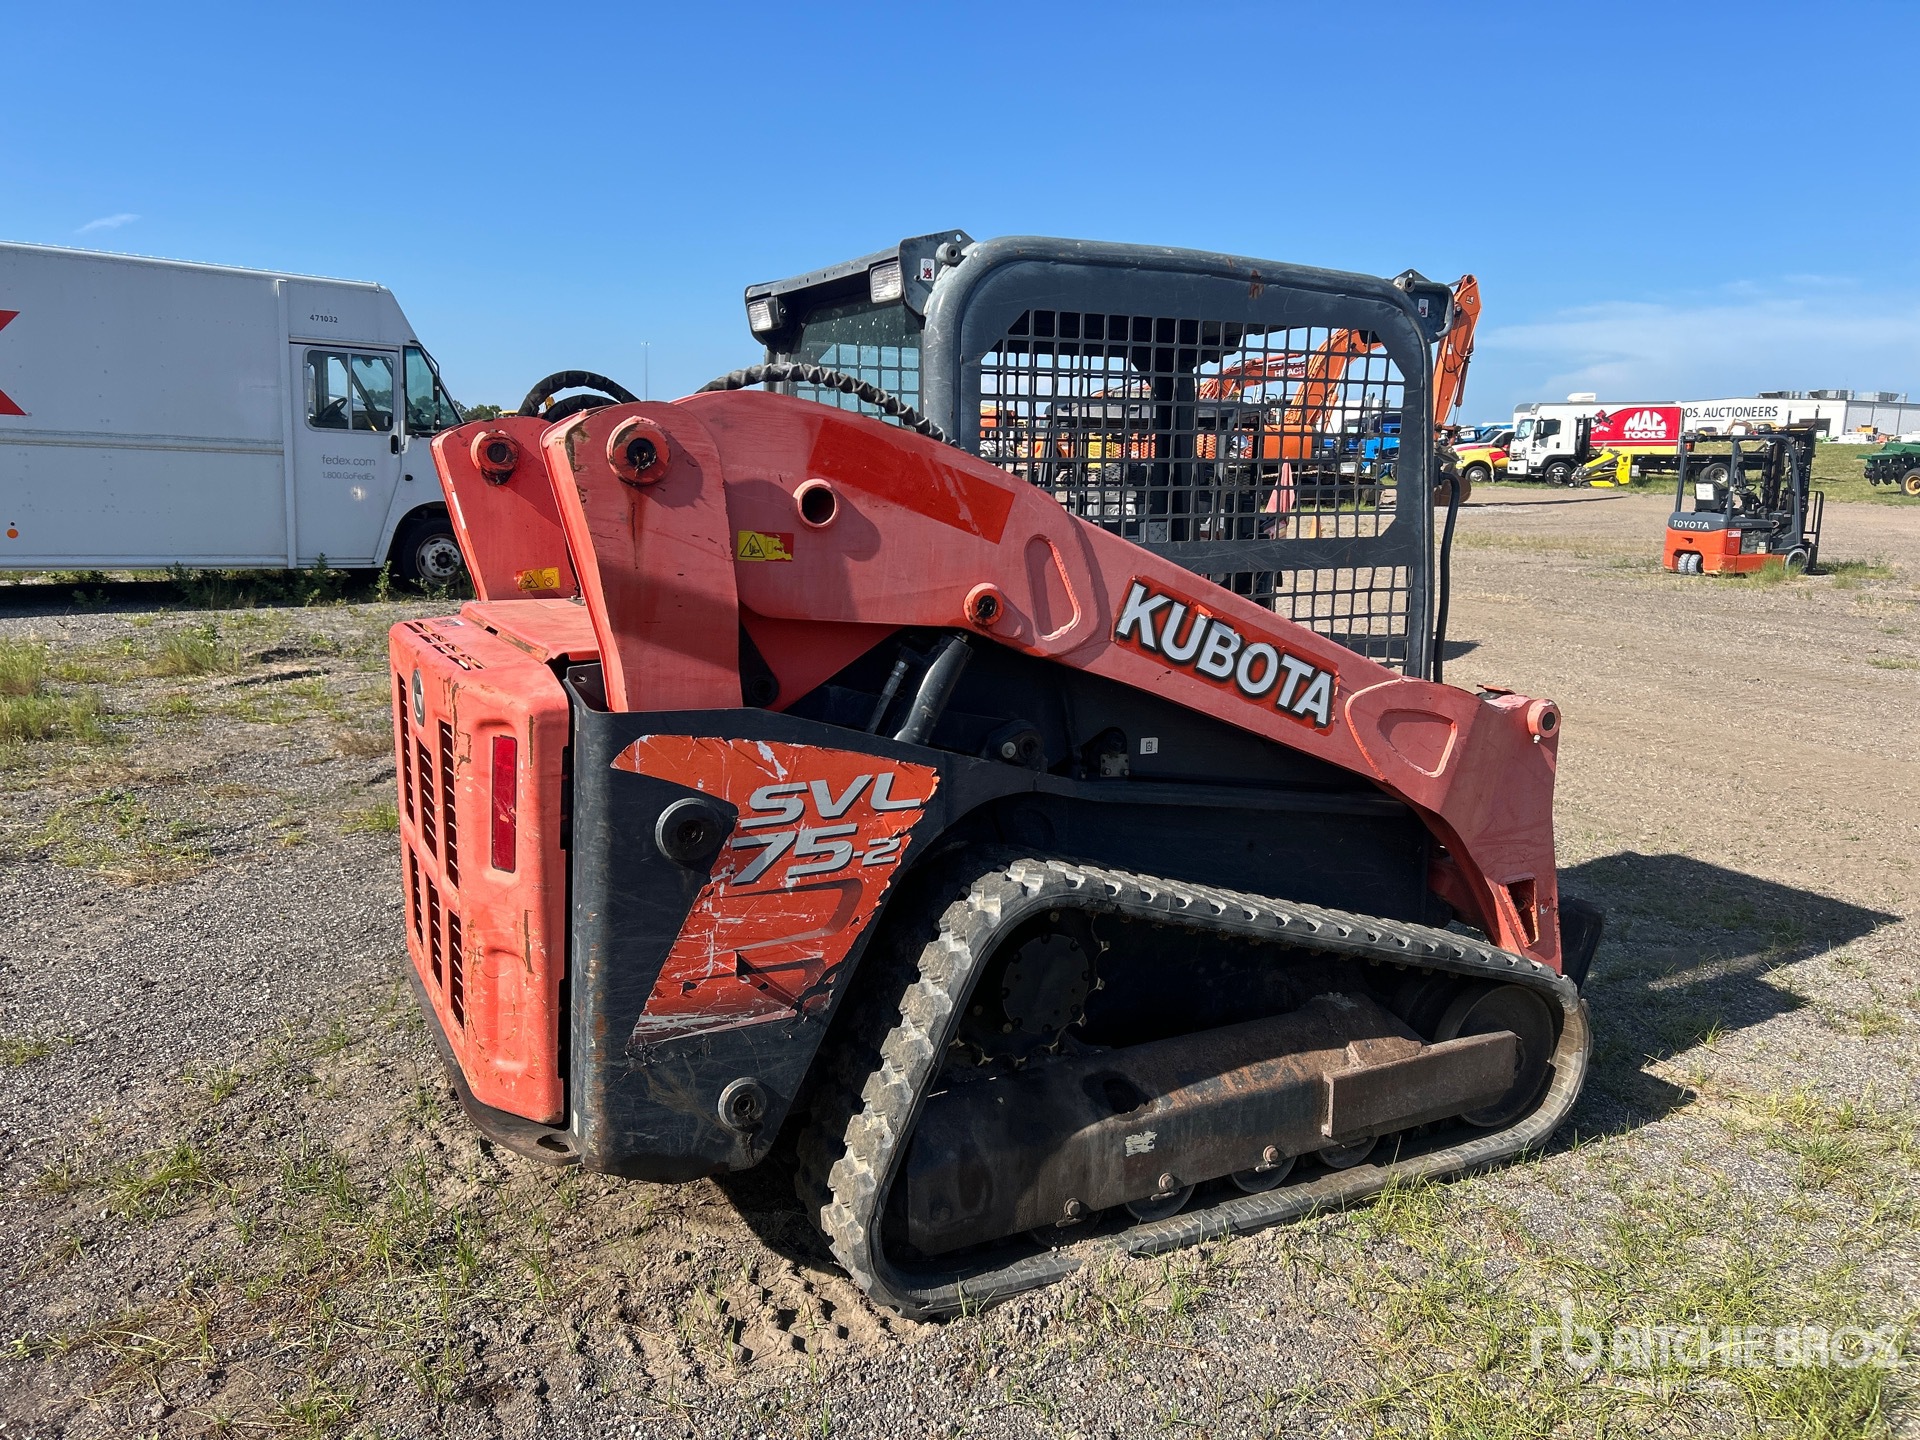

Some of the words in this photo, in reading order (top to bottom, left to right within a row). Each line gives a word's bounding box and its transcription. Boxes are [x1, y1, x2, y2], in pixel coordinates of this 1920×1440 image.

[310, 314, 338, 323] 471032
[1685, 407, 1701, 418] OS.
[1703, 406, 1778, 418] AUCTIONEERS
[1623, 410, 1667, 431] MAC
[1623, 431, 1667, 439] TOOLS
[322, 454, 376, 466] fedex.com
[1673, 520, 1710, 530] TOYOTA
[1116, 582, 1333, 726] KUBOTA
[740, 772, 922, 829] SVL
